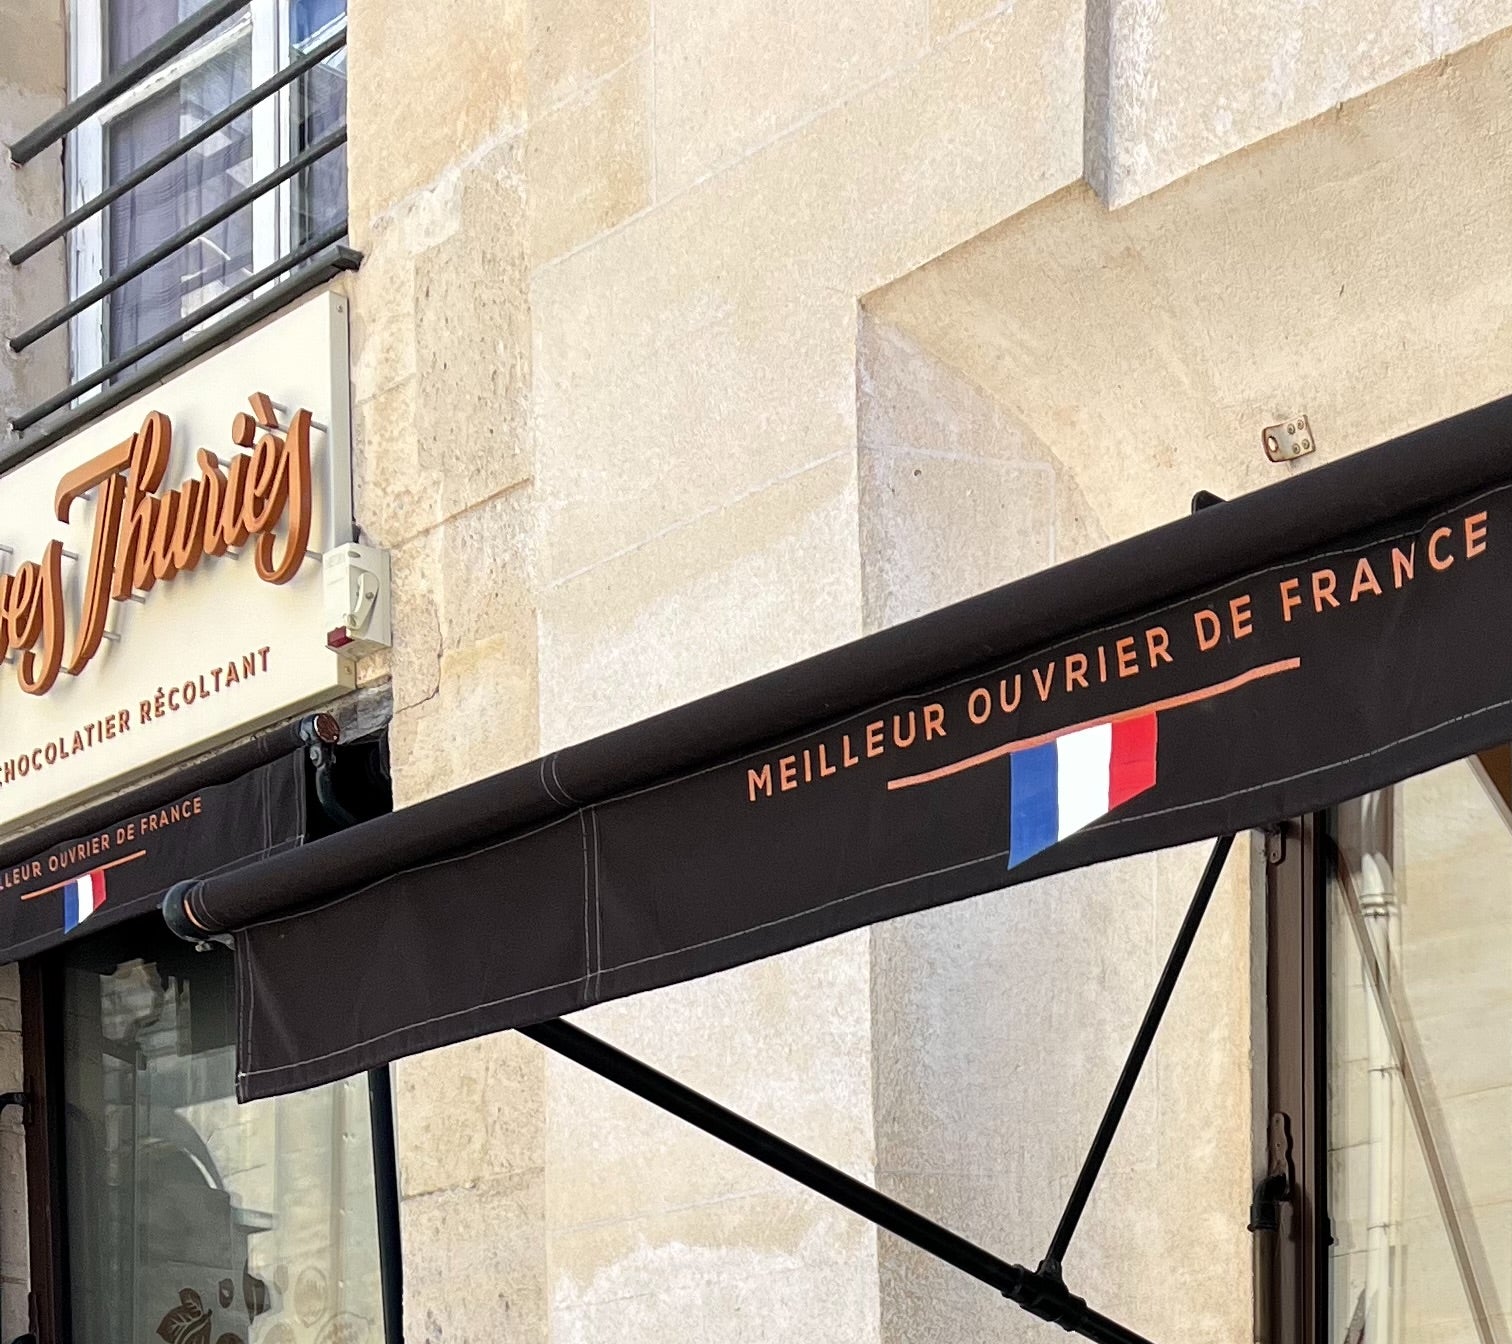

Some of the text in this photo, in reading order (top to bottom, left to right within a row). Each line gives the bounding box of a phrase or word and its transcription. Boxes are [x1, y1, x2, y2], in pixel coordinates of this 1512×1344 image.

[55, 391, 312, 677] Thuriès
[0, 646, 271, 788] HOCOLATIER RÉCOLTANT
[747, 510, 1490, 803] MEILLEUR OUVRIER DE FRANCE
[0, 797, 202, 890] LEUR OUVRIER DE FRANCE
